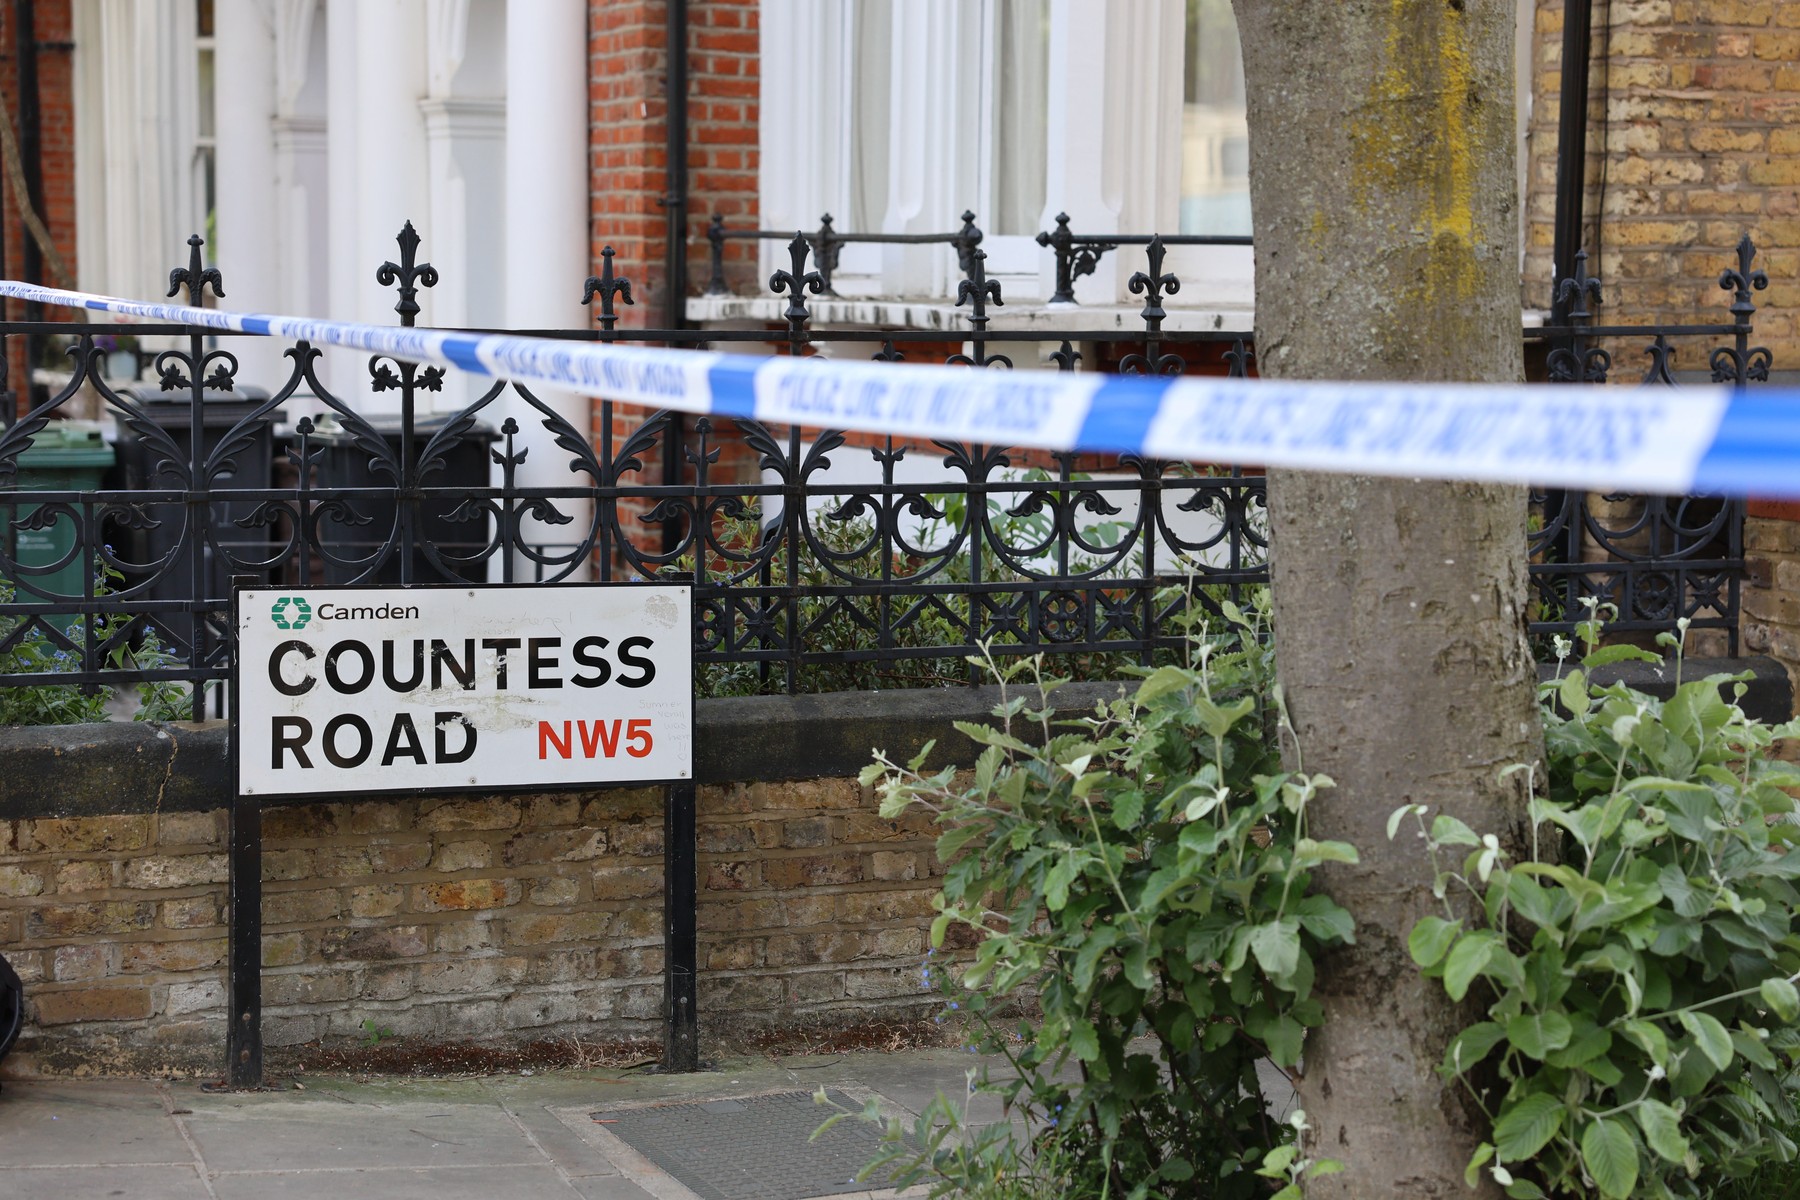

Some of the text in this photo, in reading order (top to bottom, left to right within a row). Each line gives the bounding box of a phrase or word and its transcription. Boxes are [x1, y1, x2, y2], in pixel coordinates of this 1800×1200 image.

[316, 602, 419, 620] Camden
[268, 635, 656, 696] COUNTESS
[271, 711, 653, 769] ROAD NW5
